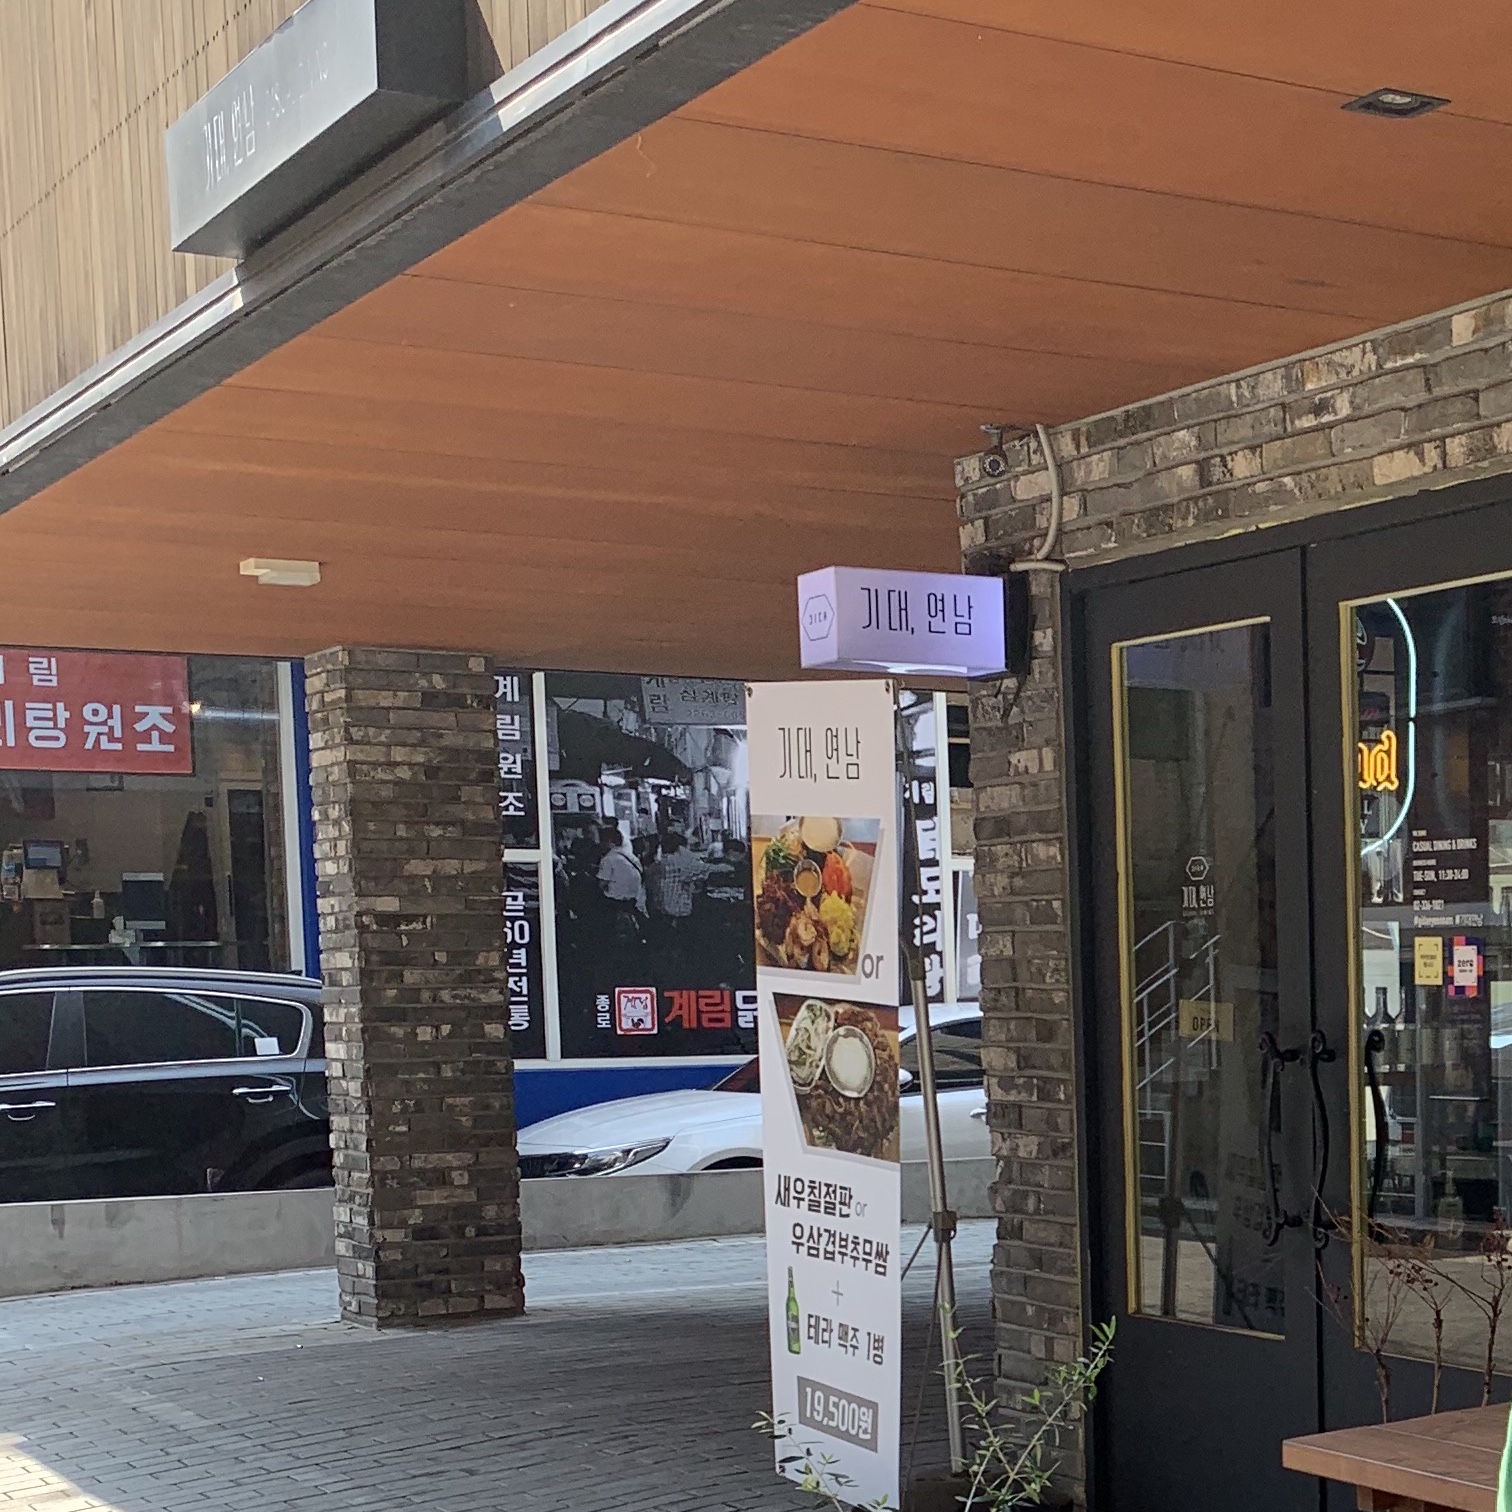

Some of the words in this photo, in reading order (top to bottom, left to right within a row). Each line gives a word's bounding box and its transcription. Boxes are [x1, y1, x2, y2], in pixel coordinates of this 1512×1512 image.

[860, 586, 914, 636] 기대,
[926, 591, 974, 636] 연남
[777, 726, 818, 784] 기대,
[825, 726, 862, 780] 연남
[860, 953, 885, 980] or
[774, 1173, 854, 1219] 새우칠절판
[790, 1222, 890, 1278] 우삼겹부추무쌈
[807, 1312, 834, 1349] 테라
[838, 1322, 860, 1357] 맥주
[866, 1331, 885, 1366] 1병
[804, 1386, 873, 1440] 19,500원
